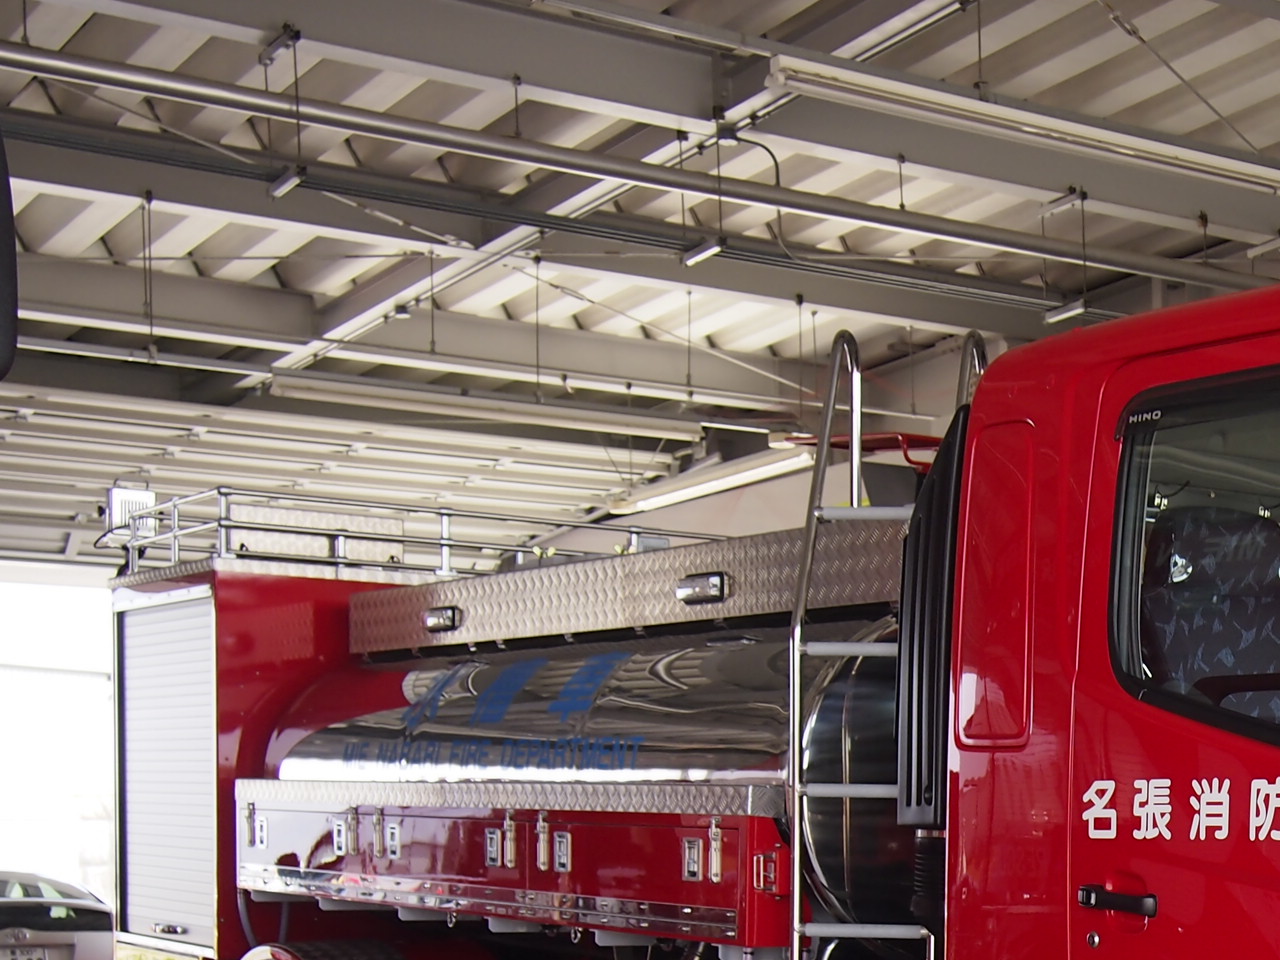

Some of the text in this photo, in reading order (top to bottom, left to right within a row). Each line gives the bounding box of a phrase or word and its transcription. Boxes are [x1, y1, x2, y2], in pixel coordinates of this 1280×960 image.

[1128, 410, 1162, 424] HINO
[450, 739, 493, 768] FIRE
[499, 736, 647, 770] DEPARTMENT
